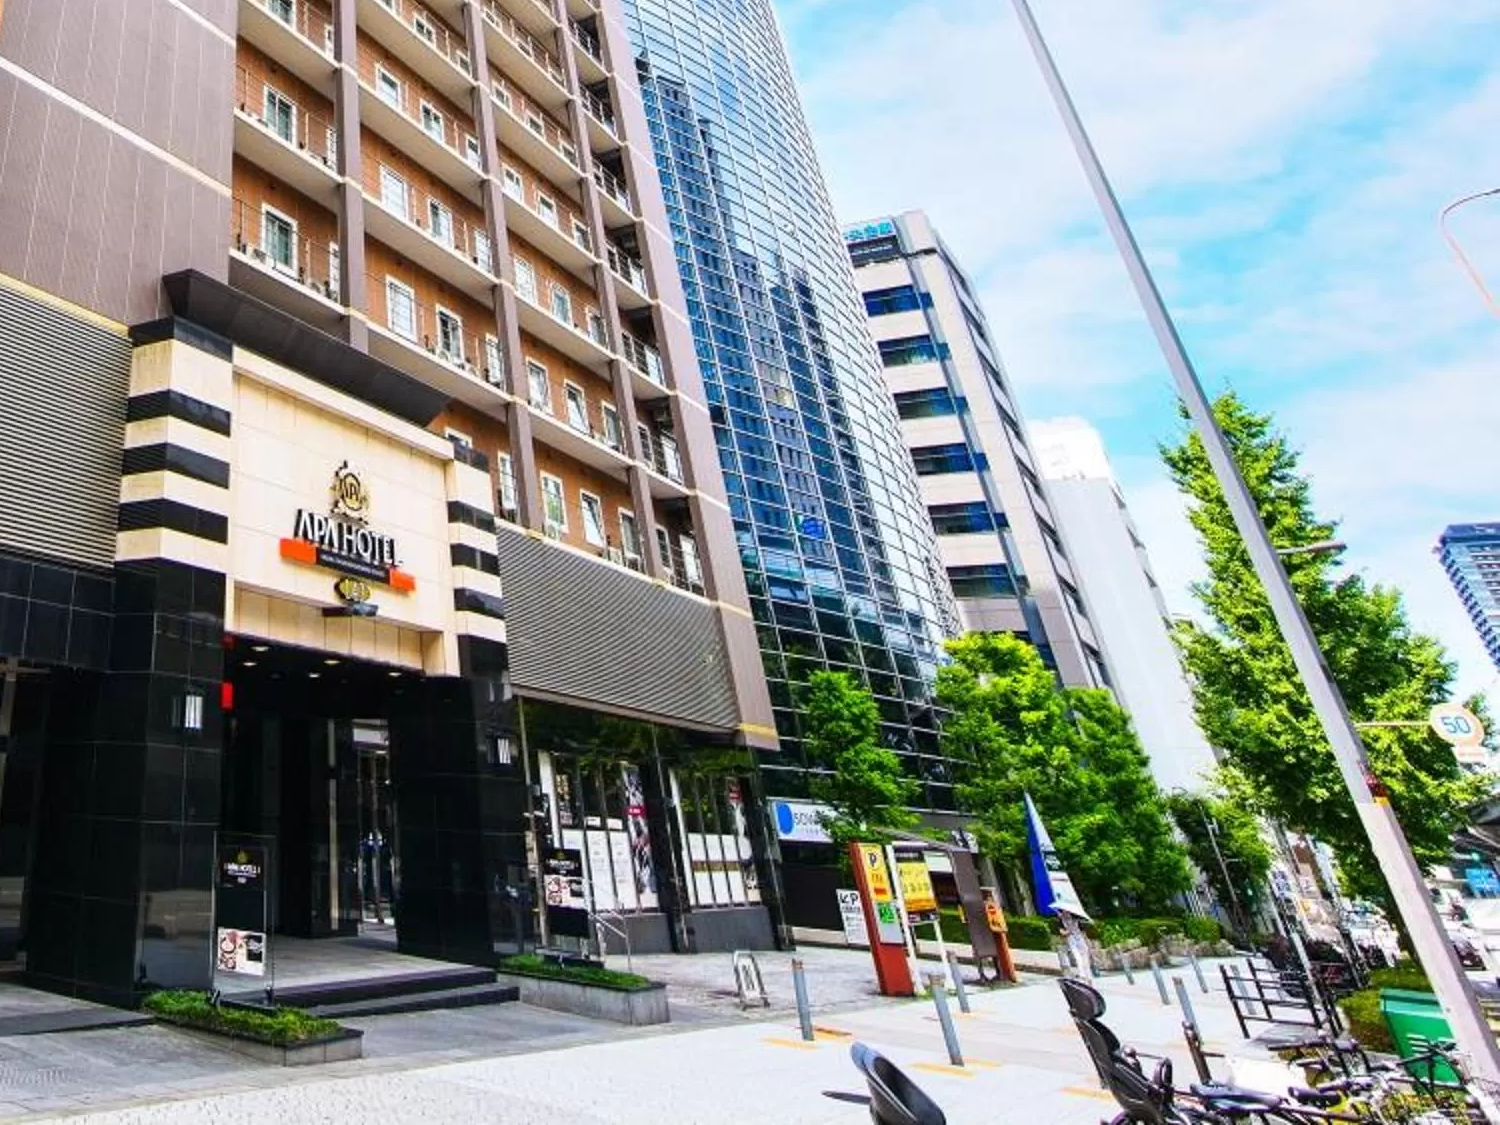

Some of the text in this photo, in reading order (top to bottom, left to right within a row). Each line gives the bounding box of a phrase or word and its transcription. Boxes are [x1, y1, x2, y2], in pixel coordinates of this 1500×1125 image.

[296, 509, 403, 565] APA HOTEL
[1440, 716, 1472, 734] 50
